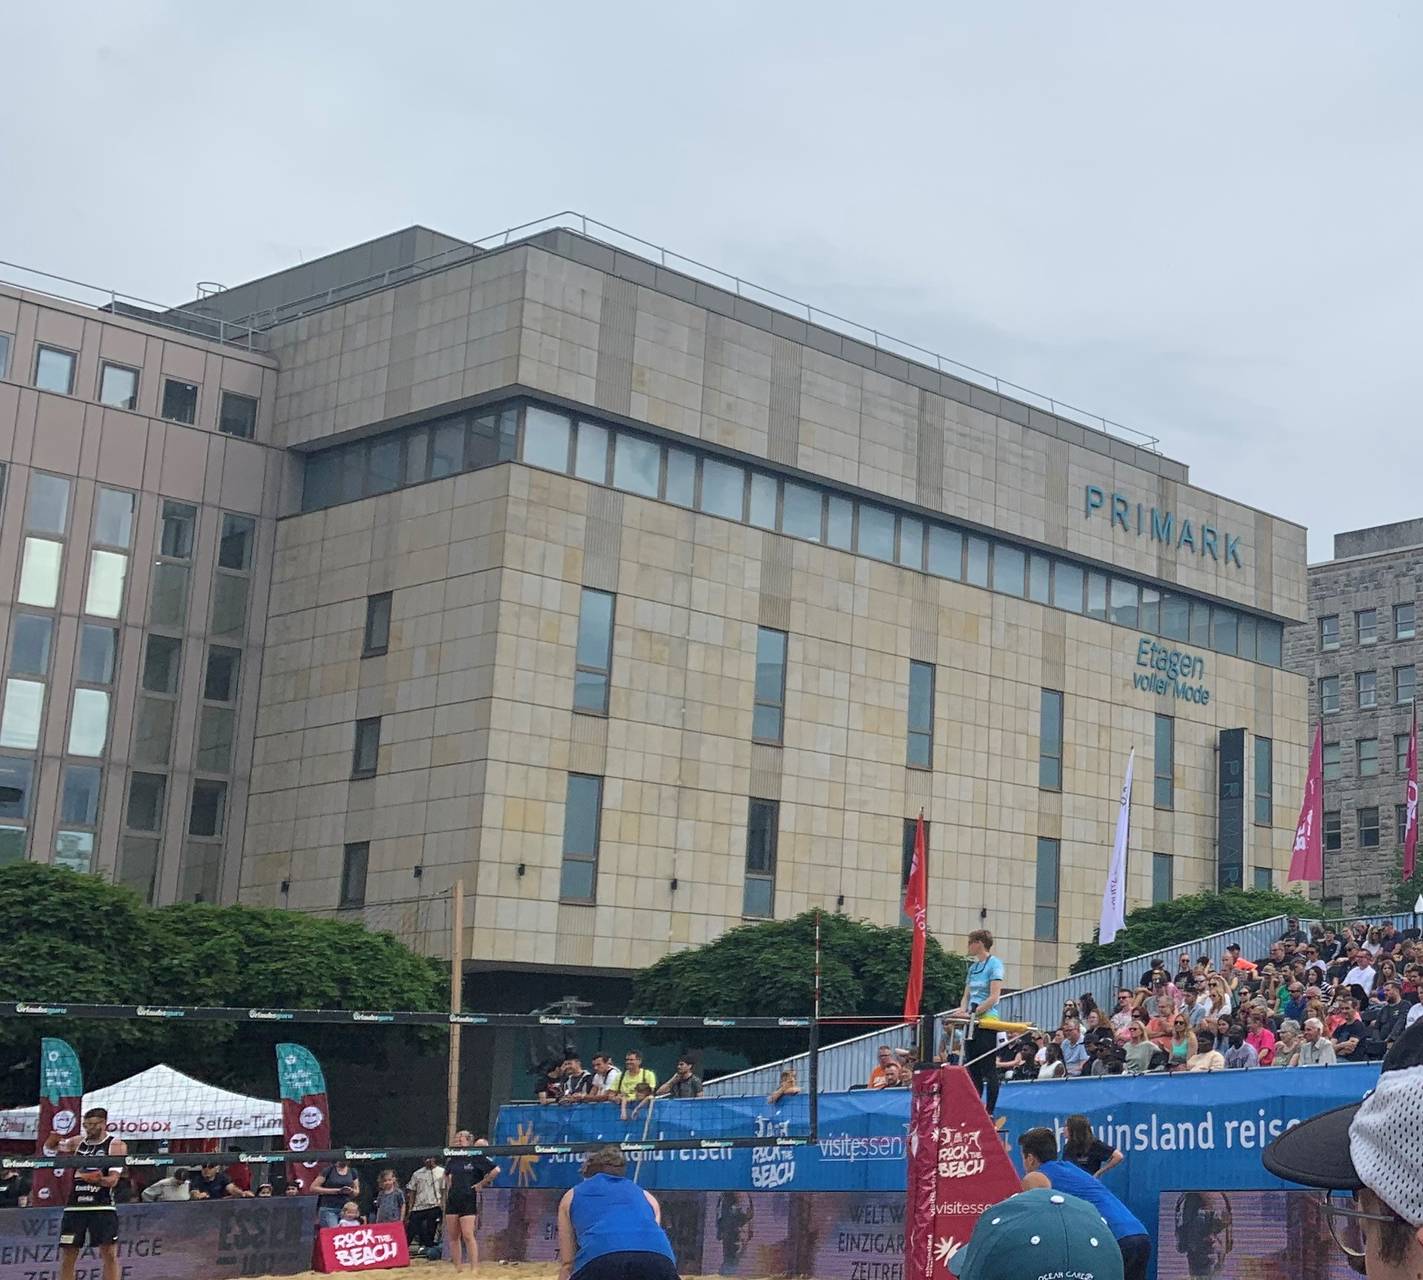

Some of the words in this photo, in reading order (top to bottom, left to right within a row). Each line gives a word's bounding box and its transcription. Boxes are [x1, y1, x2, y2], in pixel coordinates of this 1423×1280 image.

[1085, 484, 1242, 569] PRIMARK
[1136, 637, 1204, 681] Etagen
[1133, 671, 1168, 696] voller
[1173, 679, 1210, 706] Mode
[1223, 759, 1240, 883] PRIMAR
[104, 1118, 171, 1133] otobox
[195, 1114, 281, 1131] Selfie-Tim
[819, 1133, 903, 1161] visitessen
[938, 1146, 970, 1161] ROCK
[751, 1162, 795, 1189] BEACH
[938, 1159, 985, 1178] BEACH
[333, 1228, 376, 1249] ROCK
[375, 1234, 393, 1243] THE
[838, 1232, 906, 1254] EINZIGAR
[335, 1242, 397, 1267] BEACH
